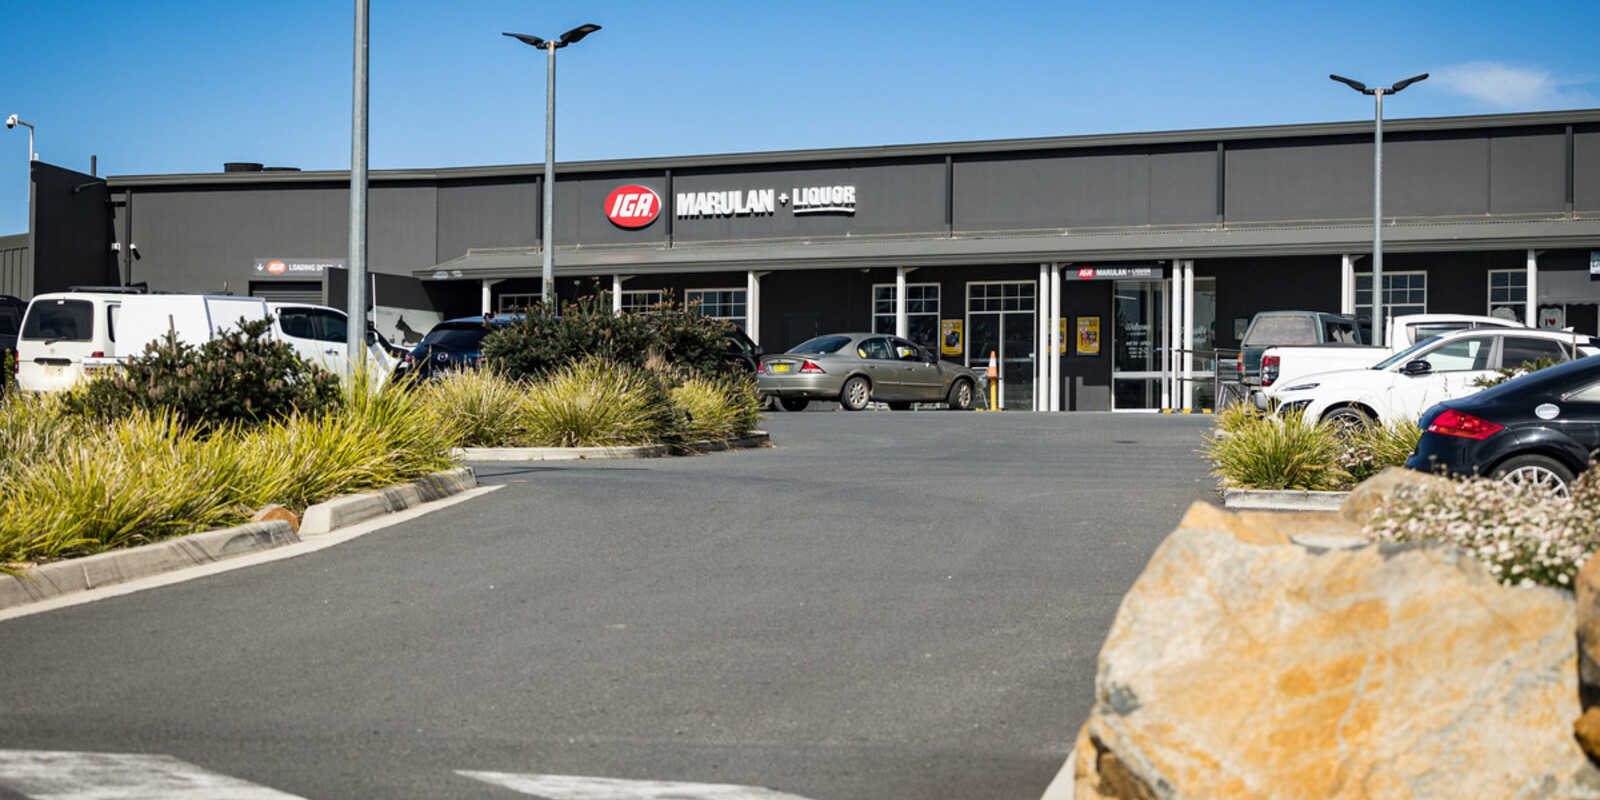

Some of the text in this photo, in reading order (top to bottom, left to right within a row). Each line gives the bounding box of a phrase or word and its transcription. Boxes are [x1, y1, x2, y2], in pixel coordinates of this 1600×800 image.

[610, 193, 653, 218] IGA
[676, 190, 774, 216] MARULAN
[793, 186, 856, 206] LIQUOR
[288, 263, 316, 272] LOADING
